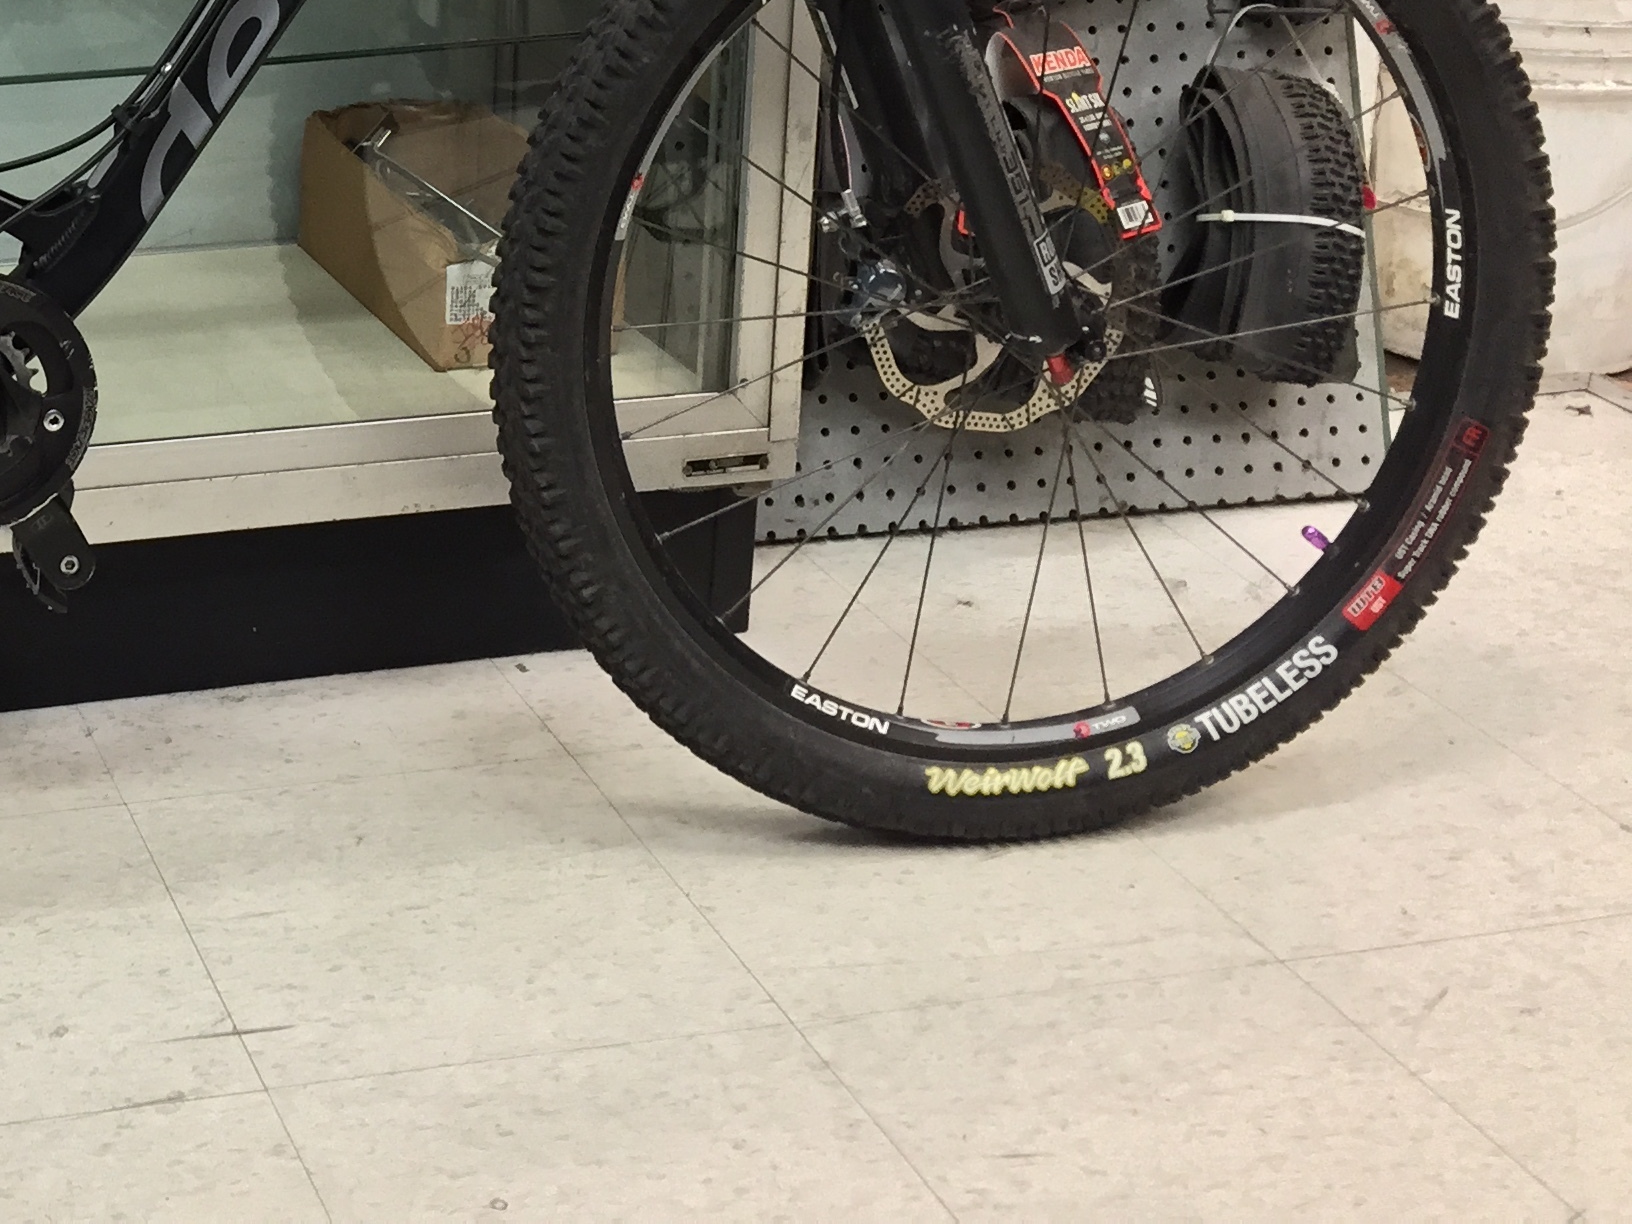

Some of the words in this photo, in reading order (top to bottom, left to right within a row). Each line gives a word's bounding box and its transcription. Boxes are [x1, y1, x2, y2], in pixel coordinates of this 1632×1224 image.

[1029, 45, 1092, 77] KENDA
[1443, 208, 1463, 320] EASTON
[1347, 575, 1386, 618] WTB
[790, 683, 890, 736] EASTON
[1194, 634, 1340, 743] TUBELESS
[1091, 714, 1128, 731] TWO
[924, 755, 1091, 797] WeirWolf
[1103, 740, 1149, 781] 2.3
